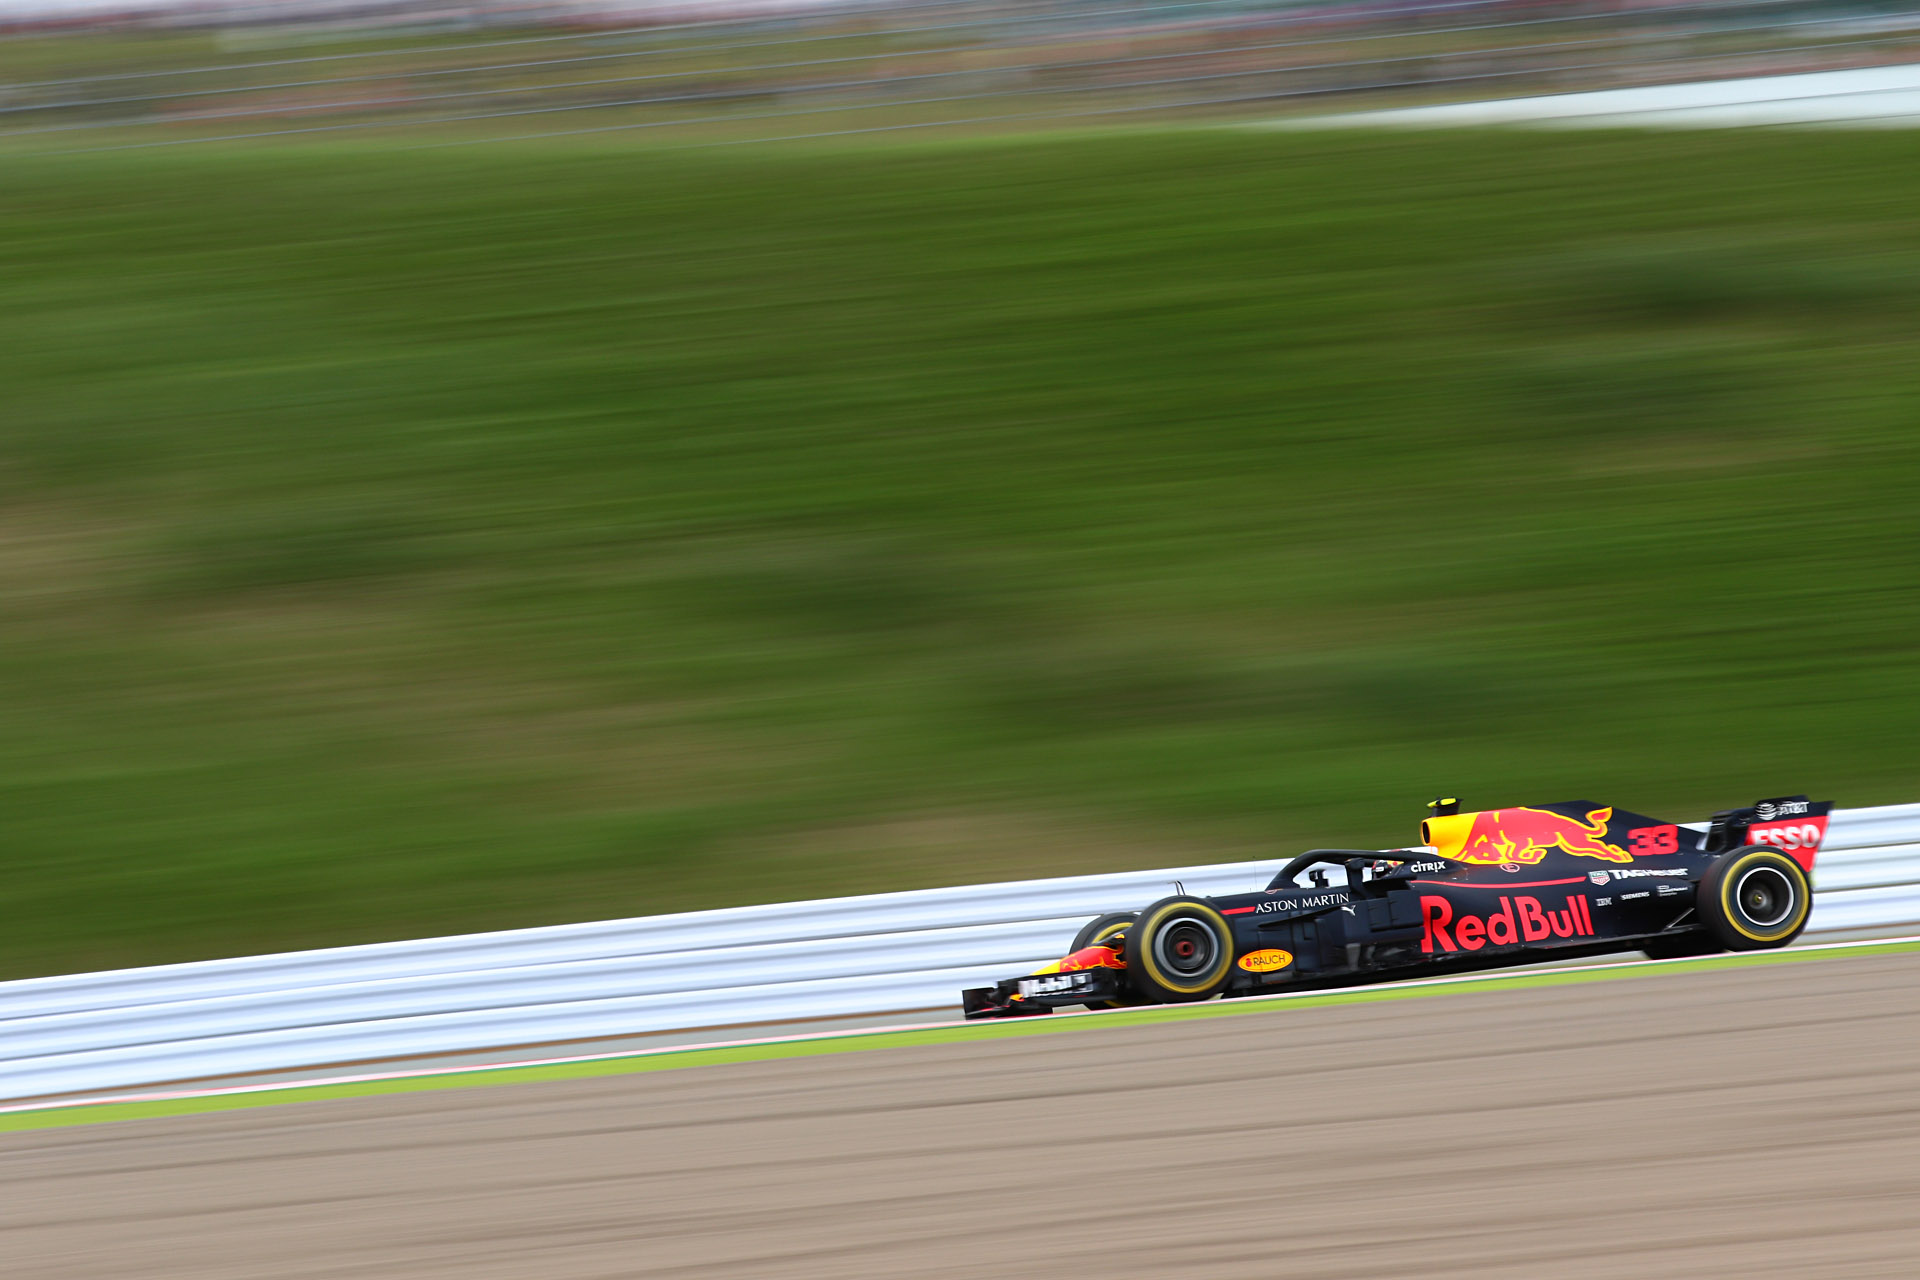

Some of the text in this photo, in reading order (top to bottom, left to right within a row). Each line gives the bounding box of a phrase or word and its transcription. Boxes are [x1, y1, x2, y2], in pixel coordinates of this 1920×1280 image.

[1627, 824, 1679, 856] 33
[1751, 824, 1820, 850] ESSO
[1255, 893, 1350, 914] ASTON MARTIN
[1253, 954, 1286, 966] RAUCH
